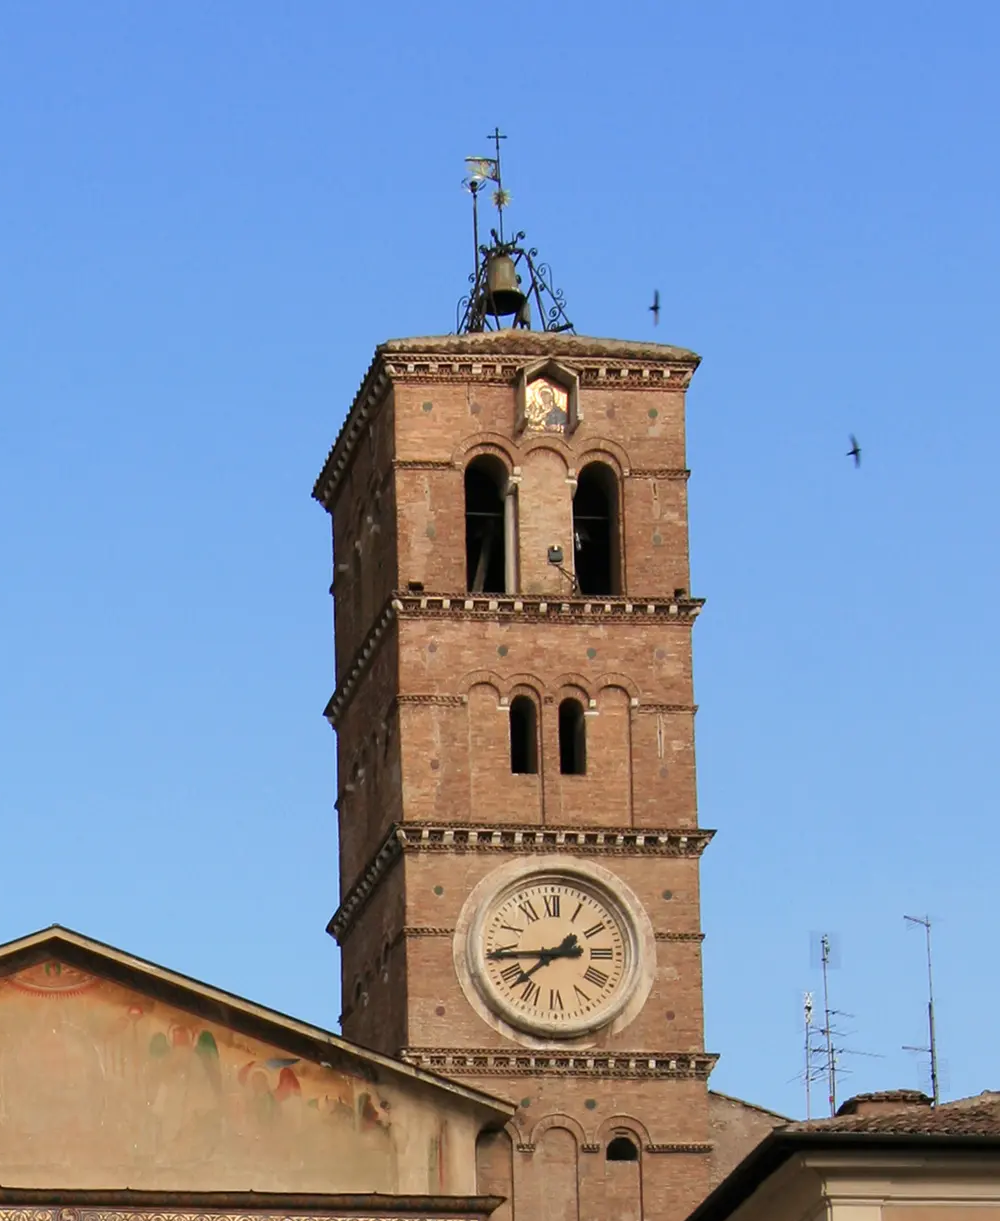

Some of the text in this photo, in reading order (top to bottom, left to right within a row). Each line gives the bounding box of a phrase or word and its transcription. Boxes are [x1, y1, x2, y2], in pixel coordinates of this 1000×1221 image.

[519, 900, 540, 925] XI
[543, 895, 560, 917] XII
[570, 903, 582, 923] I
[500, 920, 524, 938] X
[584, 921, 605, 938] II
[590, 948, 612, 960] III
[583, 965, 609, 989] IIII
[520, 980, 541, 1006] VII
[550, 989, 564, 1010] VI
[573, 984, 591, 1006] V
